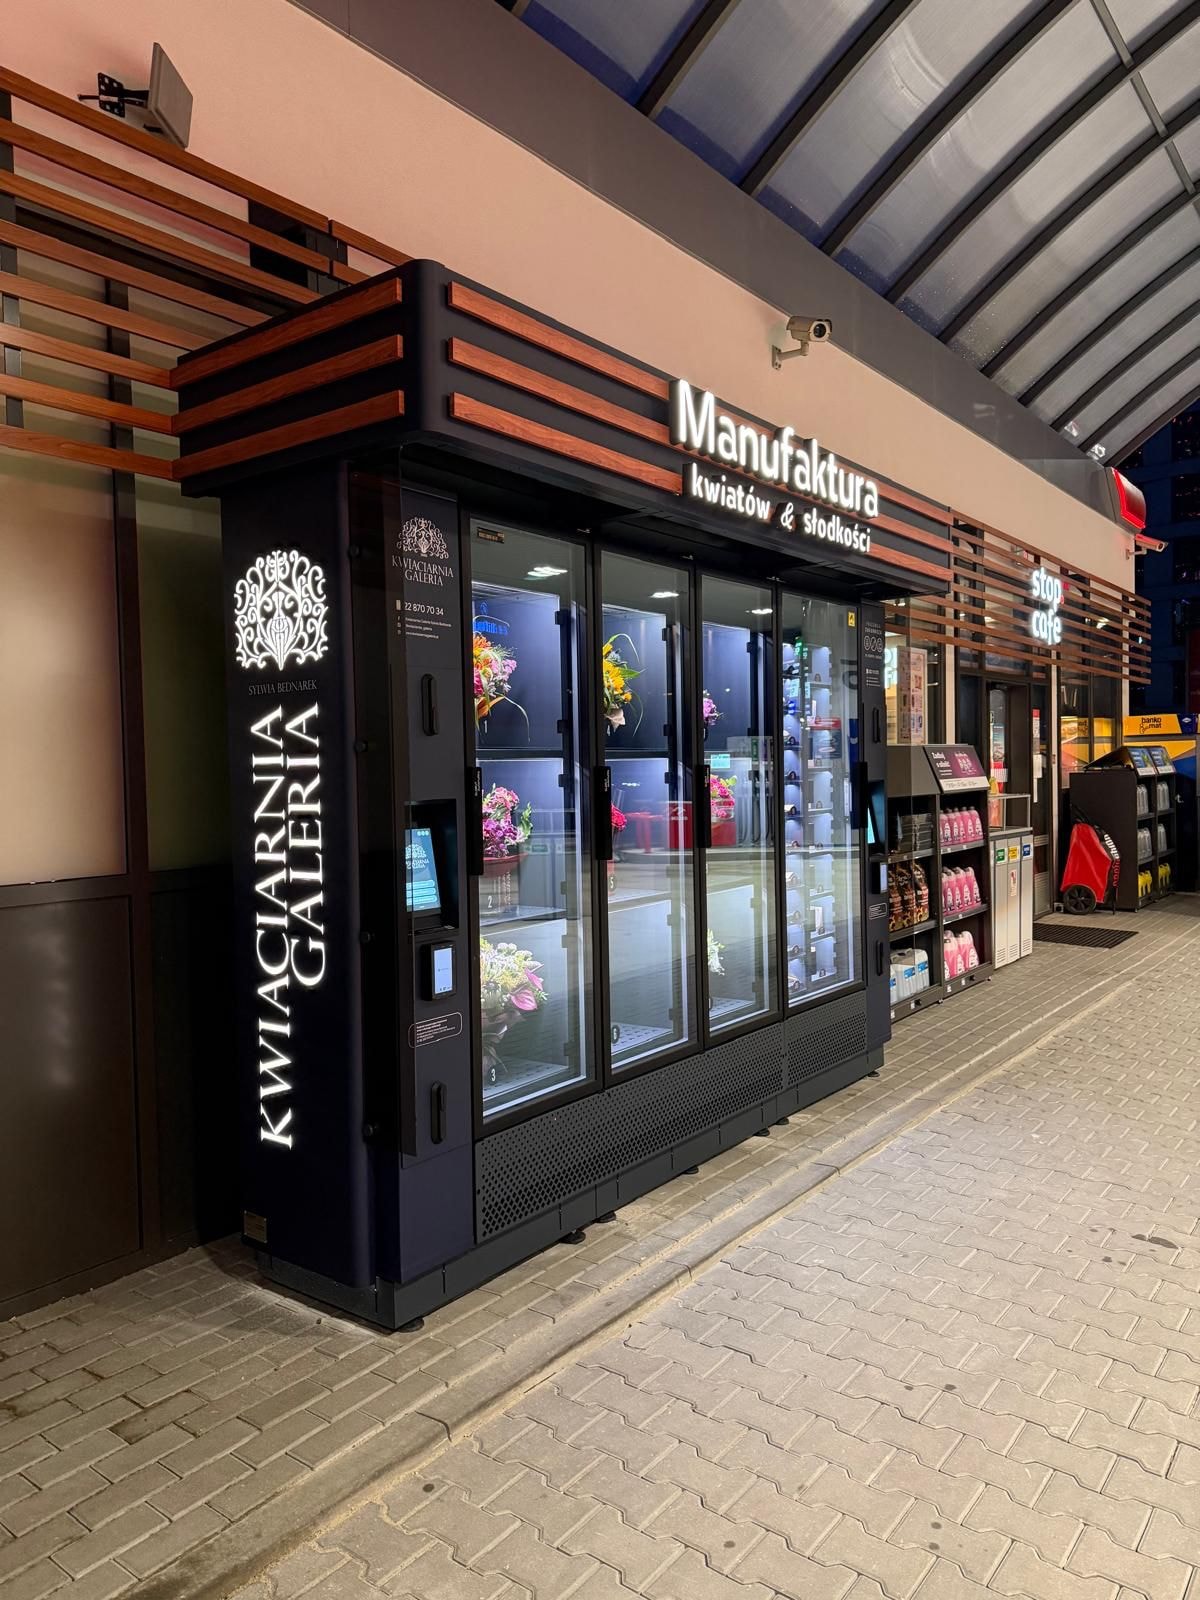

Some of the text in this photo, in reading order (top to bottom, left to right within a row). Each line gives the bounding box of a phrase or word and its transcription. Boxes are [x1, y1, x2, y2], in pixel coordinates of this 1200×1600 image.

[678, 378, 879, 518] Manufaktura
[691, 462, 871, 553] kwiatów & słodkości
[391, 555, 454, 578] KWIACIARNIA
[404, 569, 443, 587] GALERIA
[1032, 566, 1062, 613] stop
[412, 603, 426, 613] 870
[426, 605, 435, 615] 70
[435, 606, 444, 616] 34
[1032, 608, 1062, 646] cafe
[248, 679, 318, 696] SYLWIA BEDNAREK
[285, 701, 326, 987] GALERIA
[487, 895, 493, 909] 2
[250, 703, 293, 1150] KWIACIARNIA
[491, 1068, 496, 1082] 3
